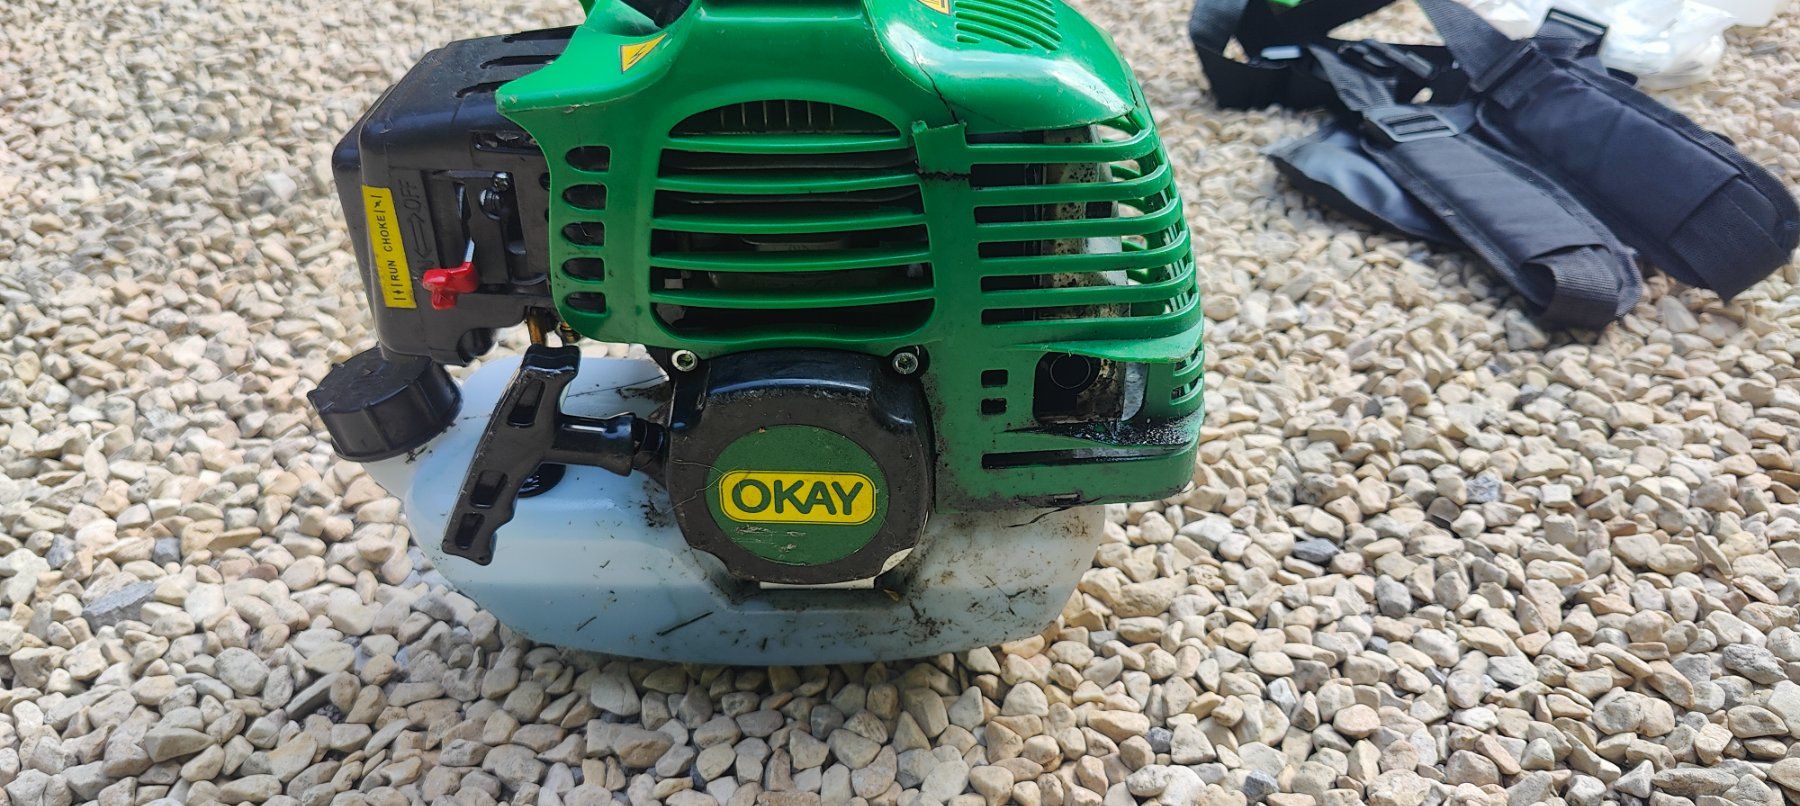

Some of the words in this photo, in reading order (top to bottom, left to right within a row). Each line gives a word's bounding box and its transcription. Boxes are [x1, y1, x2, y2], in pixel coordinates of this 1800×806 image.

[400, 180, 421, 210] OFF
[376, 214, 394, 252] CHOKE
[387, 260, 401, 282] RUN
[731, 478, 864, 516] OKAY
